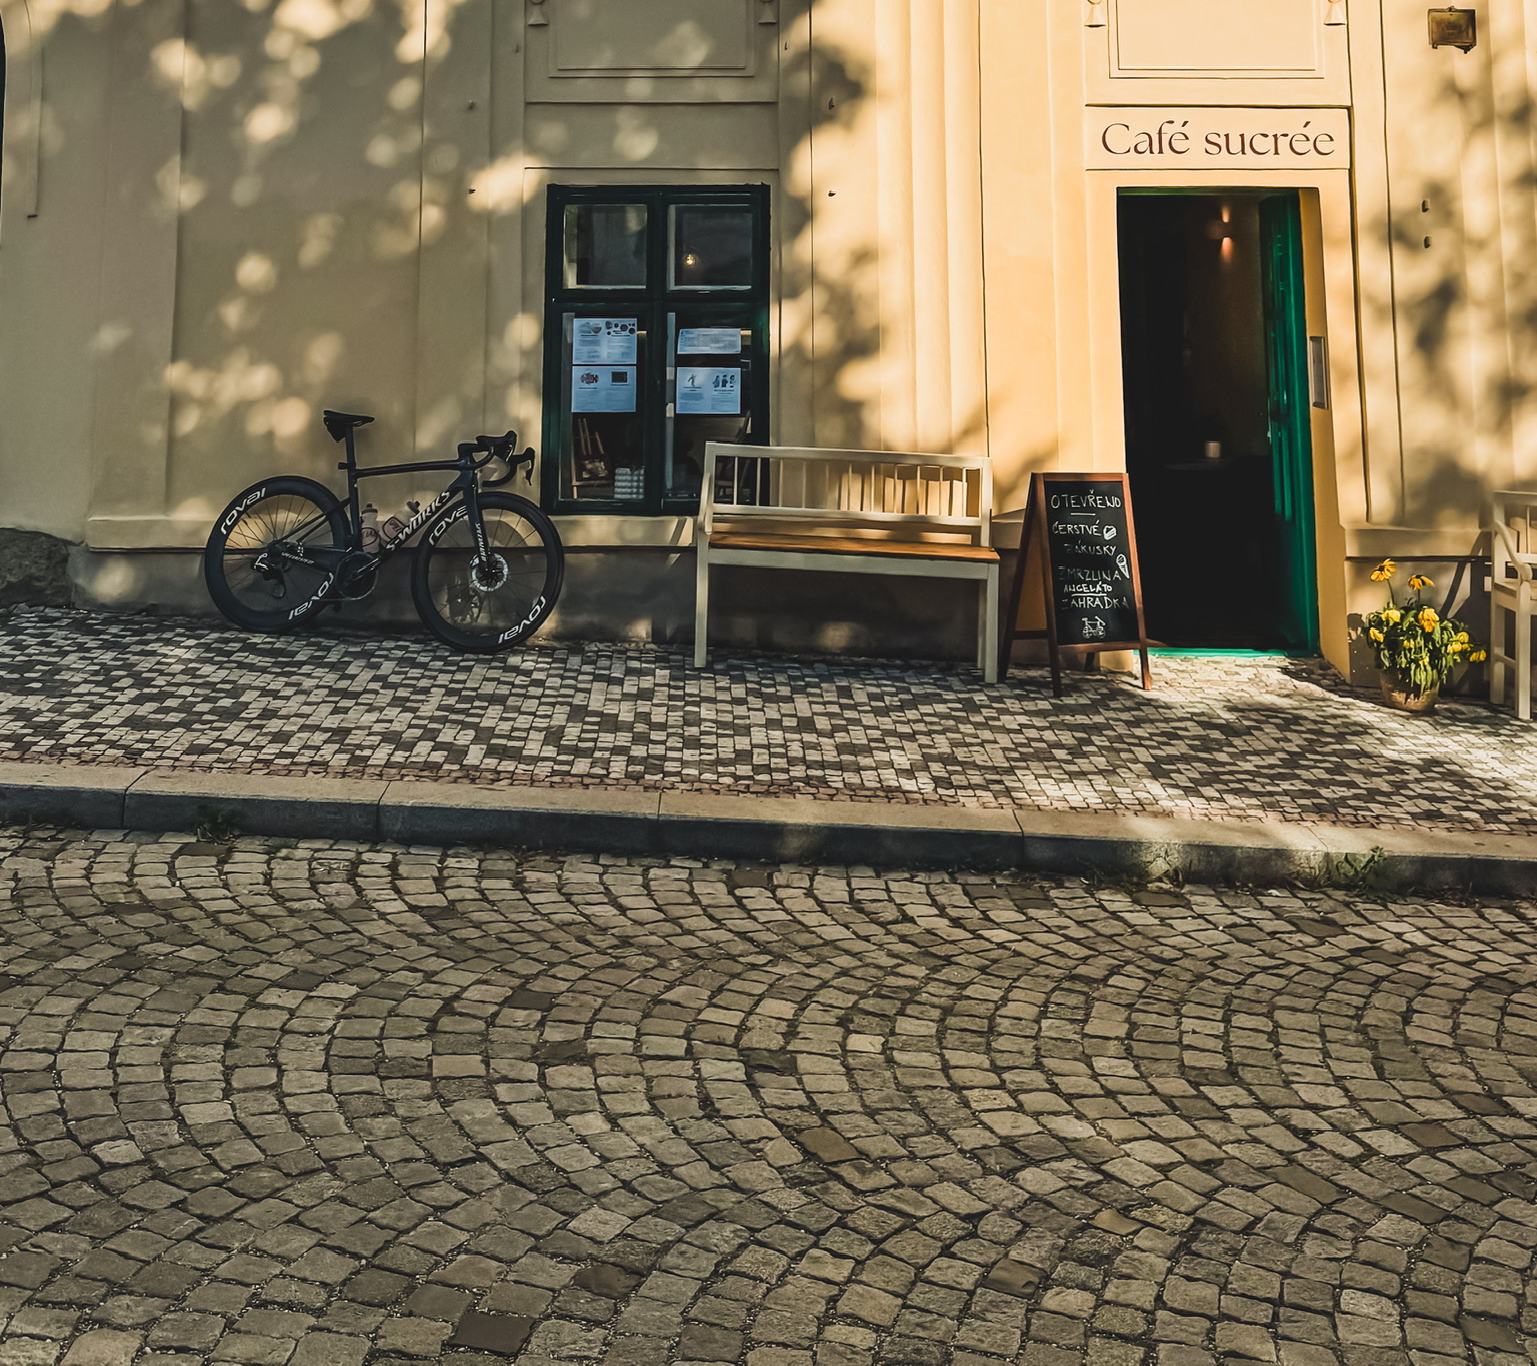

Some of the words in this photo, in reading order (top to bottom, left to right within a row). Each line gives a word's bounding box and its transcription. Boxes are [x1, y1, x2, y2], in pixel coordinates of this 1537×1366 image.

[1101, 120, 1190, 155] Café
[1204, 121, 1335, 156] sucrée
[1050, 489, 1122, 509] OTEVŘENO
[386, 491, 450, 551] S-WORKS
